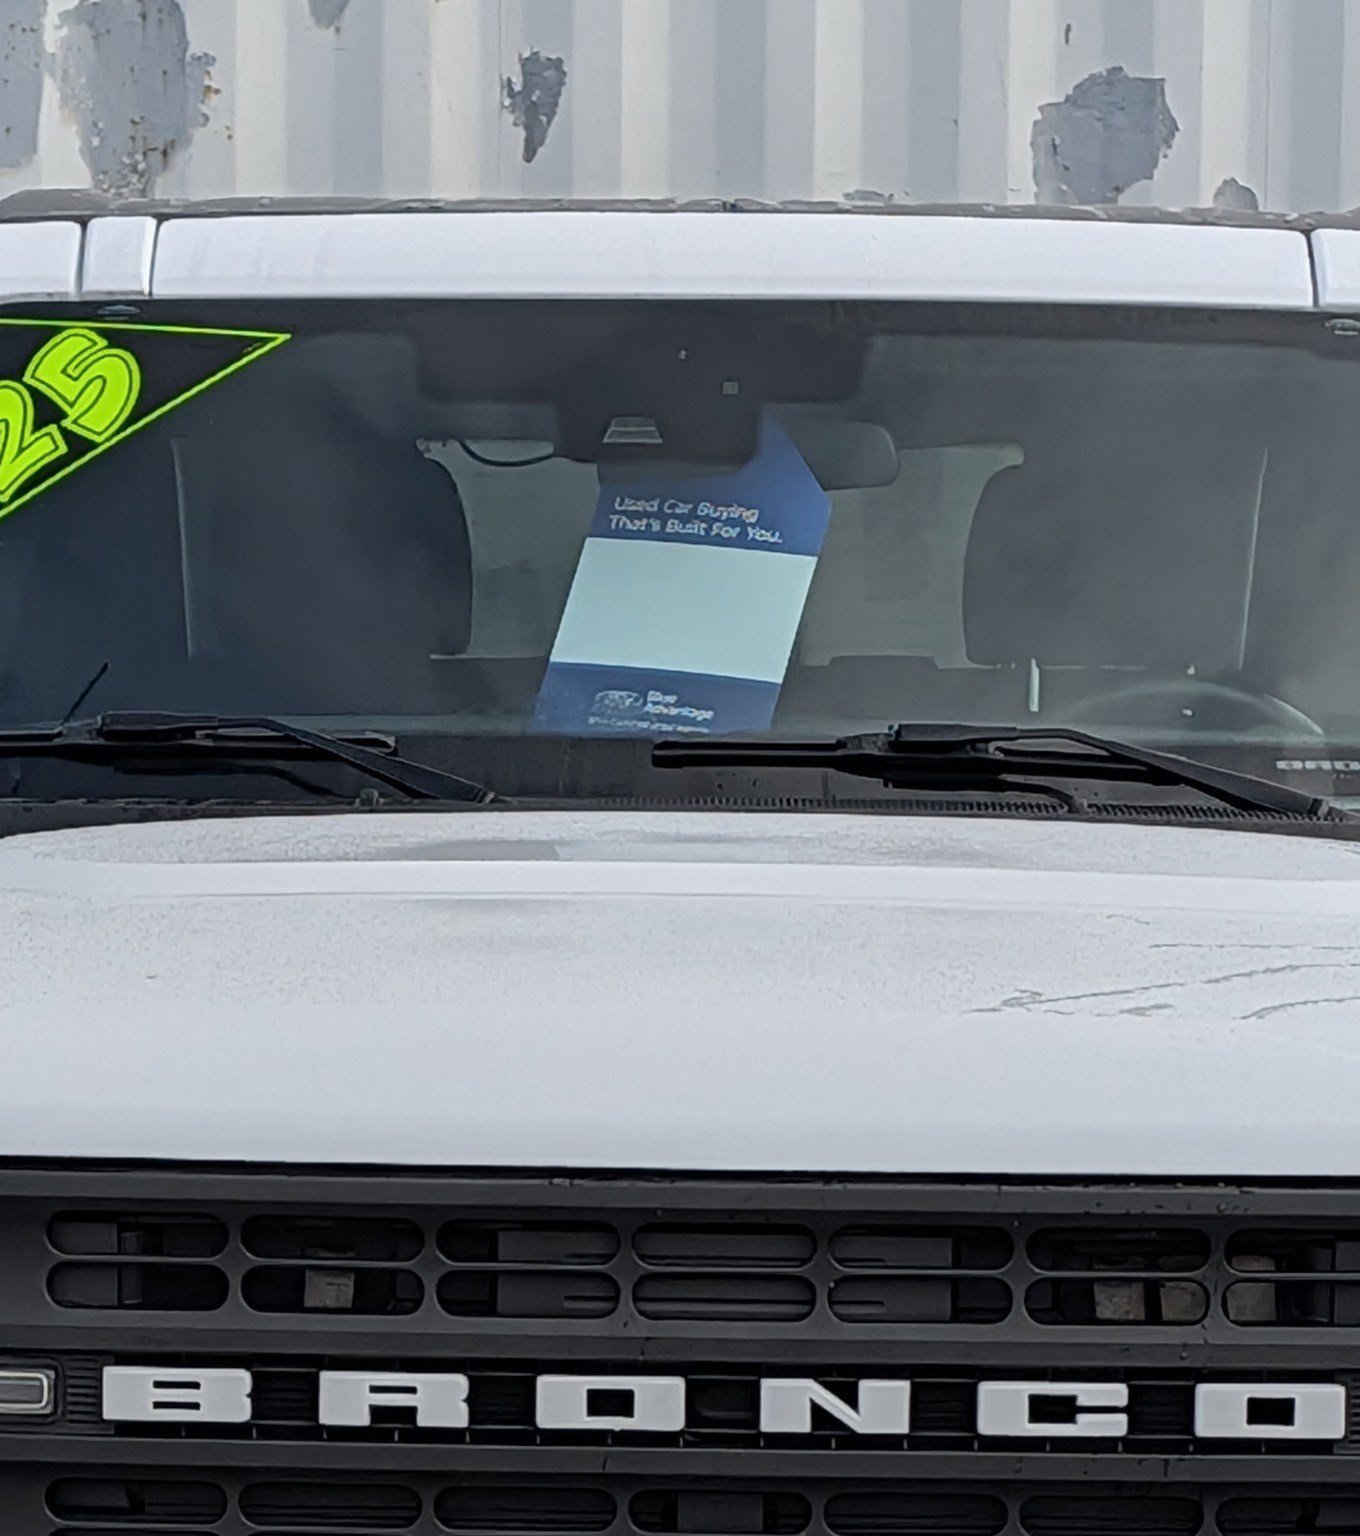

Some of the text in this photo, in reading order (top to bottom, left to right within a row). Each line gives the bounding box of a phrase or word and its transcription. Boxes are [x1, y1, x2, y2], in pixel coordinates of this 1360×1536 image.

[614, 497, 759, 524] Used Car Buying
[609, 514, 661, 531] That's
[665, 518, 708, 536] Built
[710, 522, 741, 539] For
[102, 1366, 1346, 1439] BRONCO
